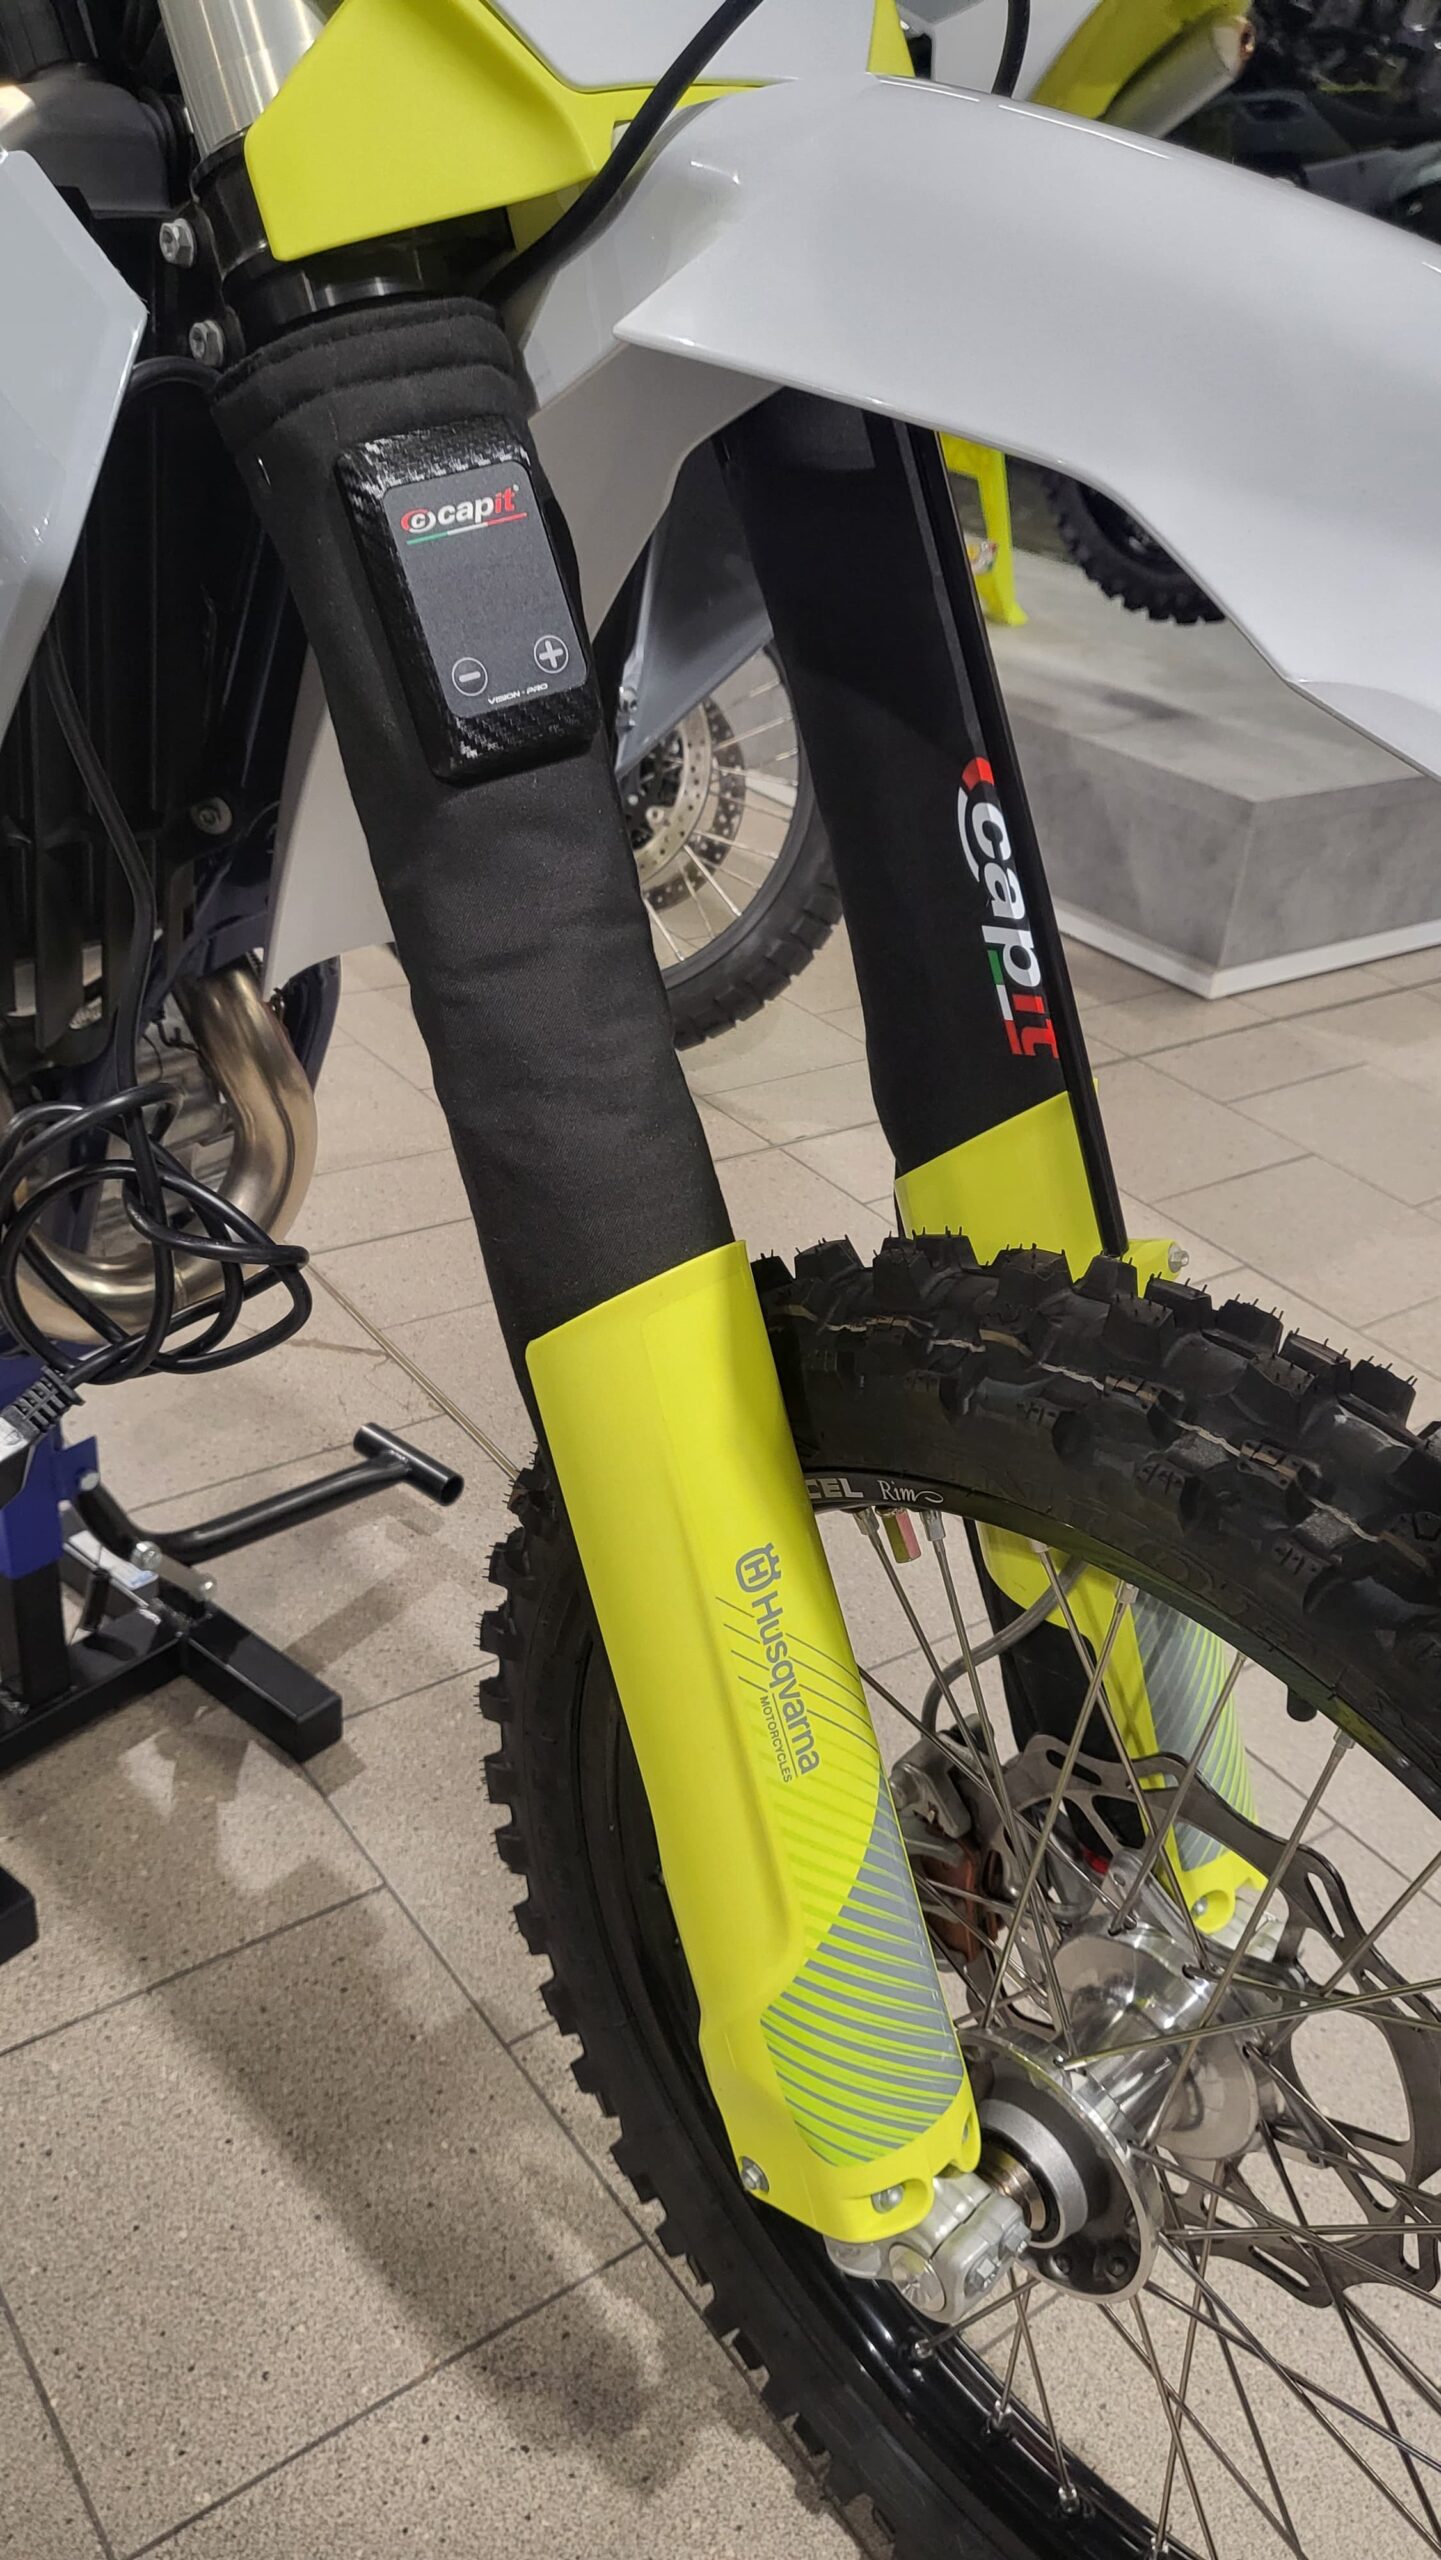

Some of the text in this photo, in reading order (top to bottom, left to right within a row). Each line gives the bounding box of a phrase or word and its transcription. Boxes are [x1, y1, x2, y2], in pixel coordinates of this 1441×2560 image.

[438, 487, 516, 525] capit
[488, 683, 549, 705] VISION PRO
[972, 802, 1060, 1059] capit
[877, 1479, 944, 1504] Rim
[752, 1591, 820, 1775] Husqvarna
[759, 1695, 793, 1784] MOTORCYCLES
